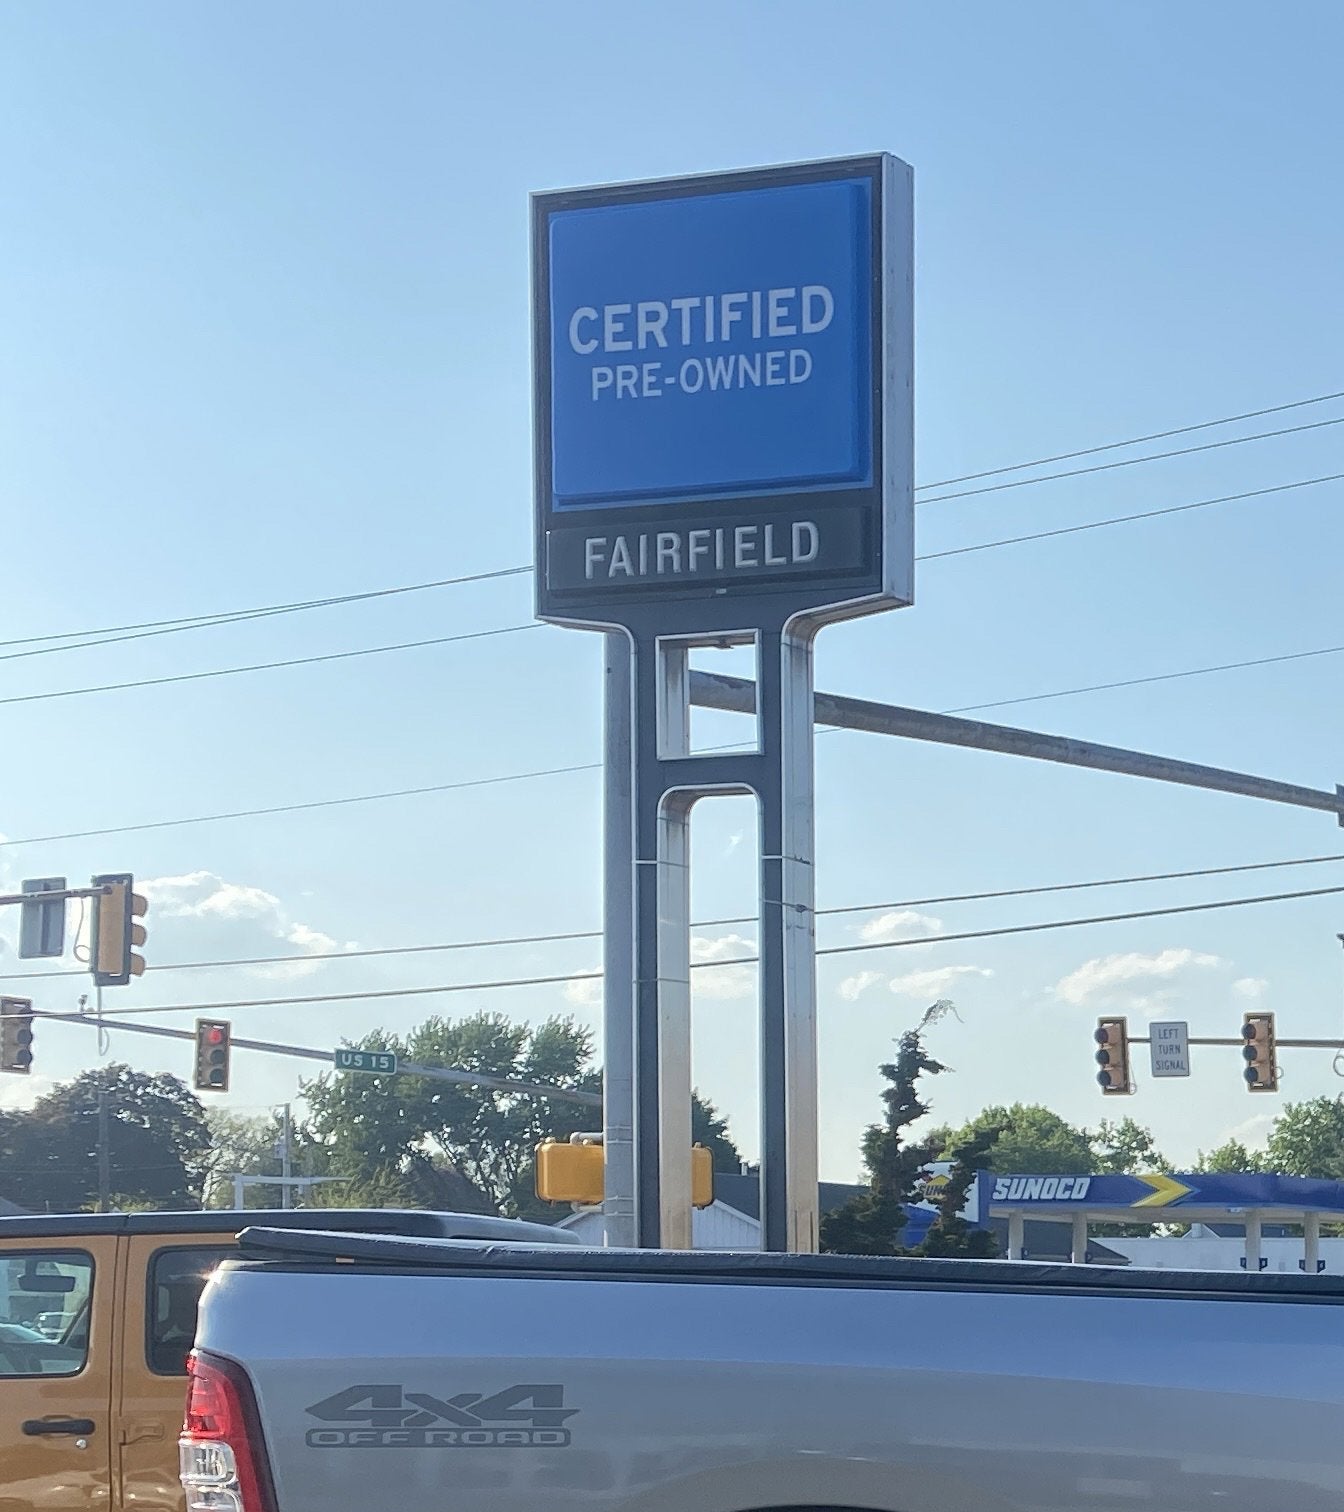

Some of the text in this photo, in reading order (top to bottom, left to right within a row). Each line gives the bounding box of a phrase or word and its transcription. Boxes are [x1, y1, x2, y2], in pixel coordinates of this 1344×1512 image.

[568, 285, 835, 355] CERTIFIED
[591, 348, 813, 401] PRE-OWNED
[584, 520, 820, 580] FAIRFIELD
[1157, 1028, 1179, 1040] LEFT
[1157, 1044, 1181, 1055] TURN
[341, 1053, 389, 1069] US 15
[1155, 1060, 1186, 1071] SIGNAL
[991, 1177, 1091, 1200] SUNOCO
